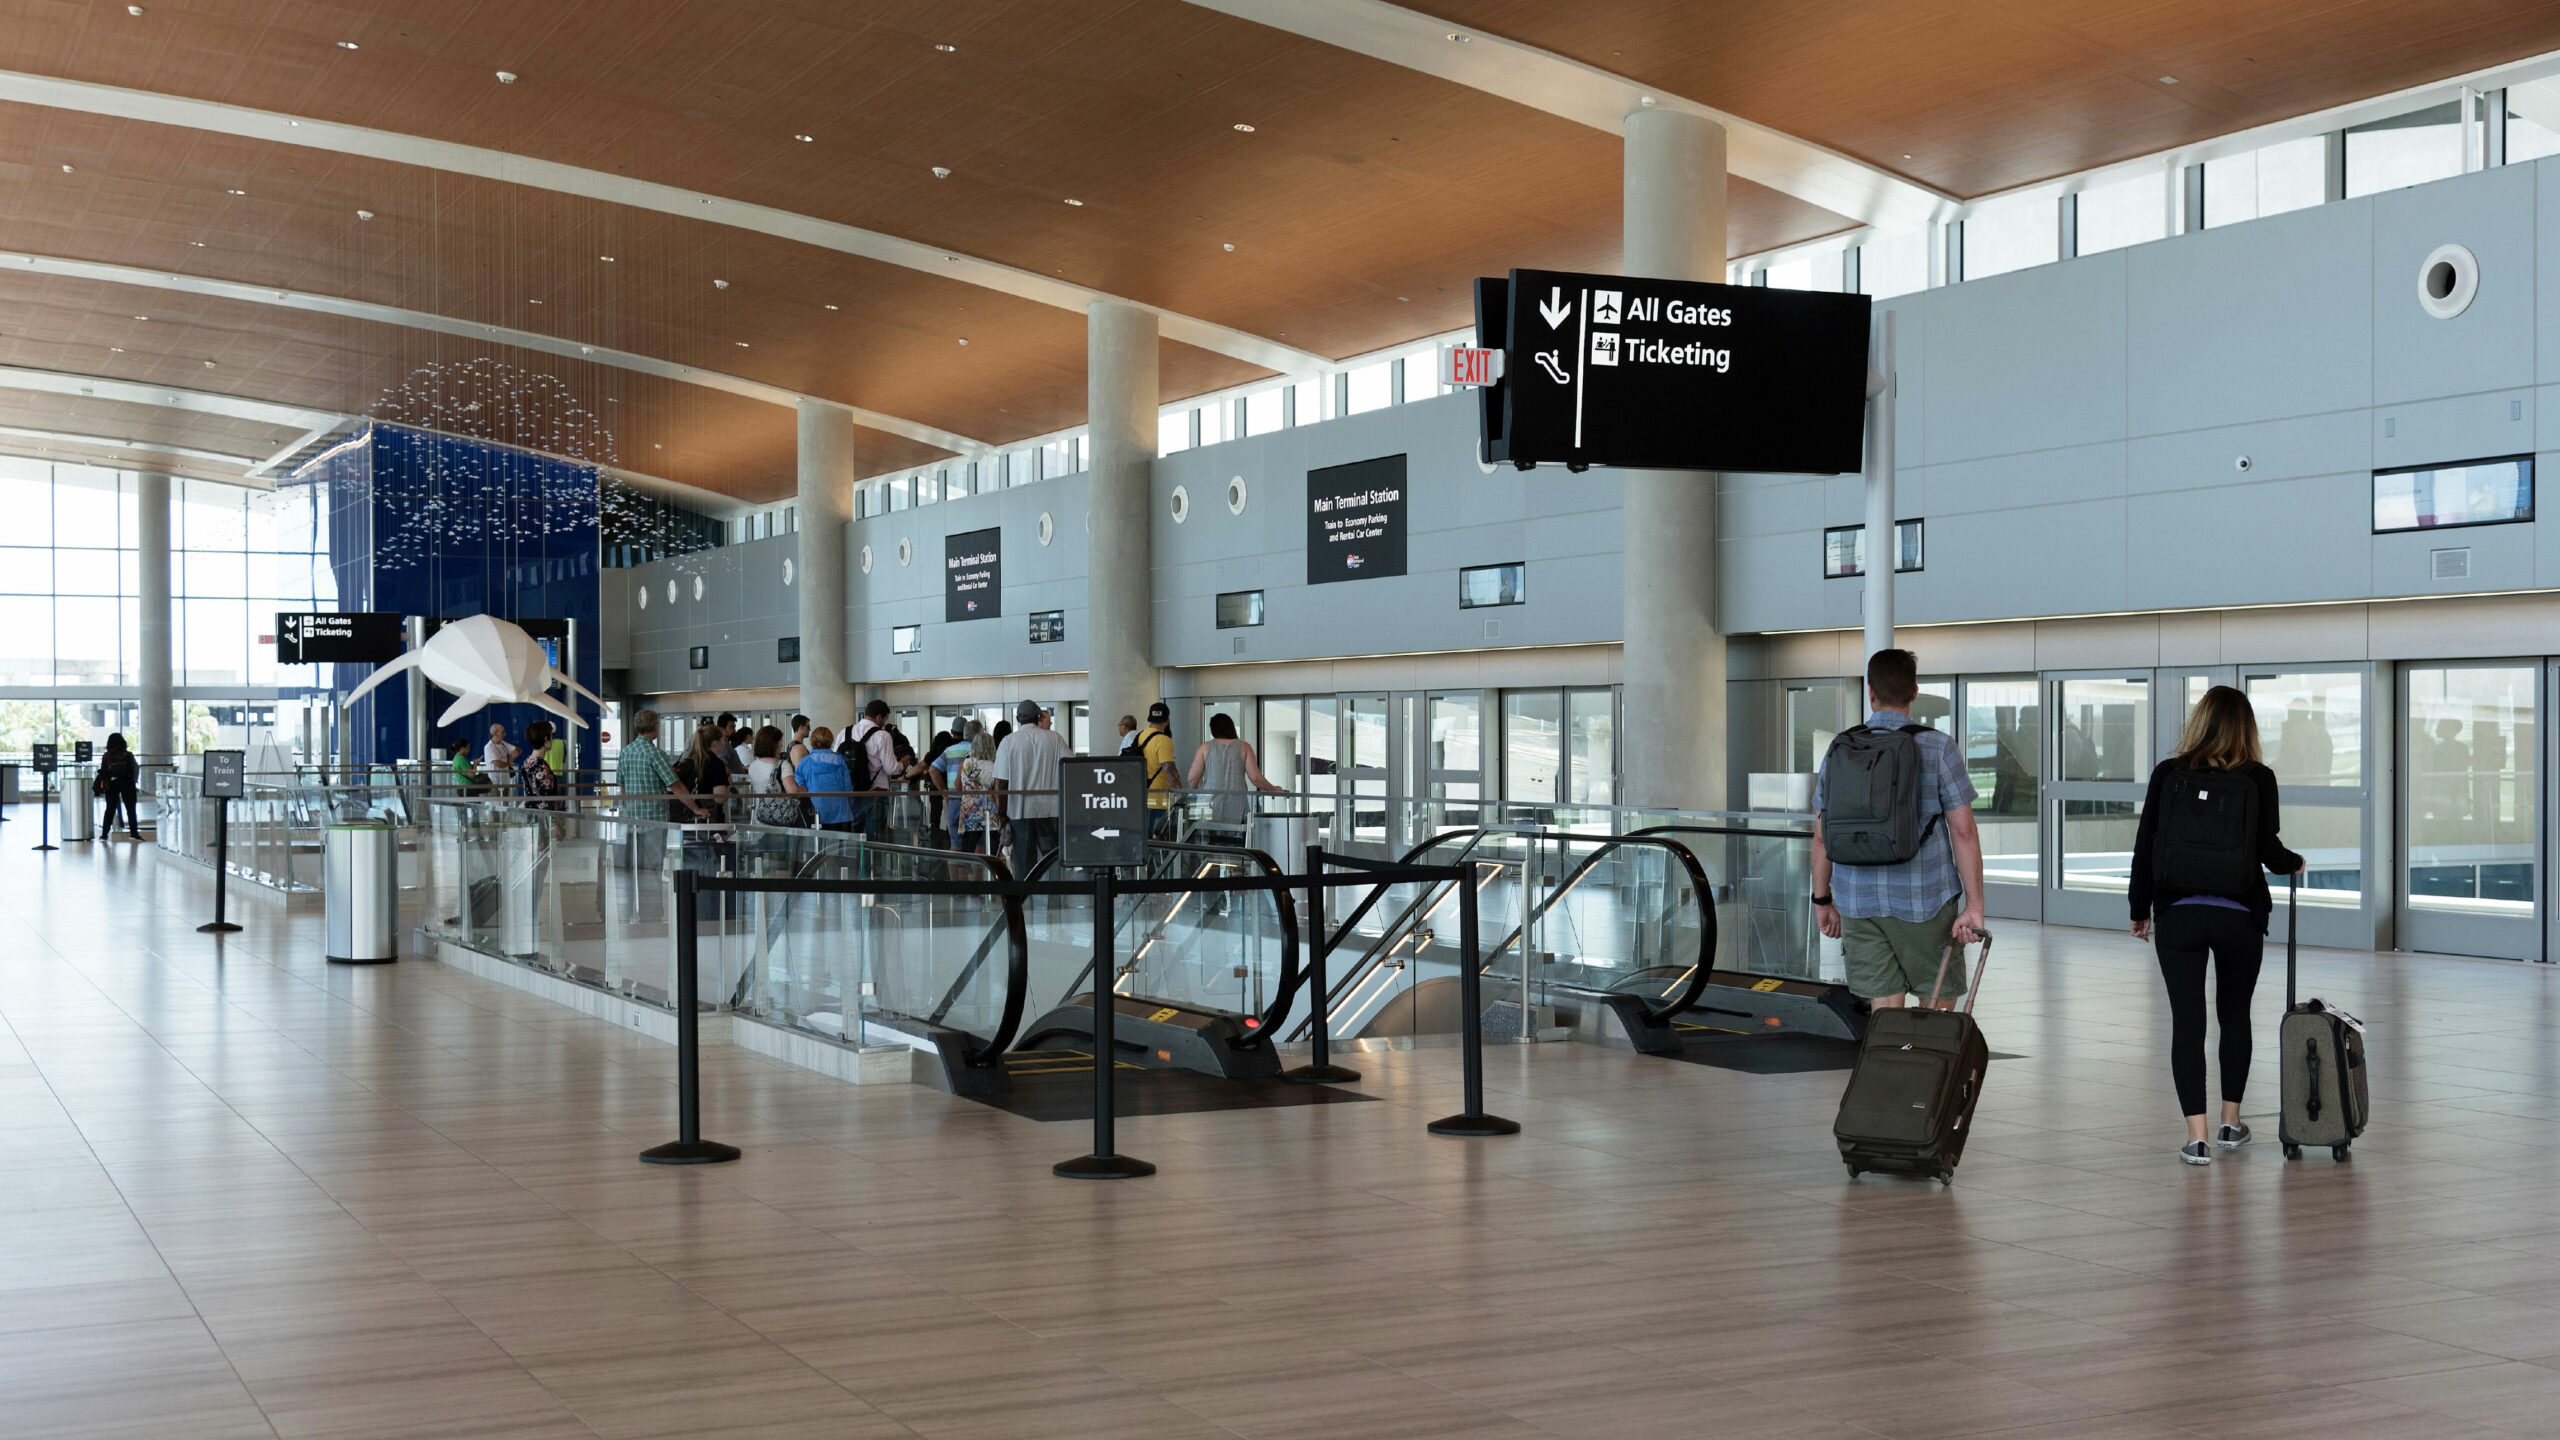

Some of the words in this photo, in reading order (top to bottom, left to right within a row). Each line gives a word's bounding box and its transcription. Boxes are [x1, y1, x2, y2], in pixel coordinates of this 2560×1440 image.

[1627, 297, 1659, 322] All
[1666, 300, 1732, 326] Gates
[1625, 338, 1731, 373] Ticketing
[1454, 349, 1491, 383] EXIT
[1314, 497, 1333, 513] Main
[1334, 490, 1368, 510] Terminal
[1370, 487, 1399, 505] Station
[1324, 520, 1337, 530] Train
[1337, 520, 1343, 528] to
[1345, 516, 1367, 527] Economy
[1368, 513, 1388, 525] Parking
[1329, 532, 1339, 542] and
[1339, 530, 1355, 541] Rental
[1356, 529, 1365, 539] Car
[1365, 527, 1383, 537] Center
[948, 557, 960, 569] Main
[960, 553, 980, 567] Terminal
[980, 551, 997, 564] Station
[315, 616, 326, 625] All
[328, 617, 352, 626] Gates
[315, 628, 352, 638] Ticketing
[219, 755, 230, 764] To
[213, 766, 235, 775] Train
[1093, 768, 1116, 785] To
[1081, 792, 1128, 809] Train
